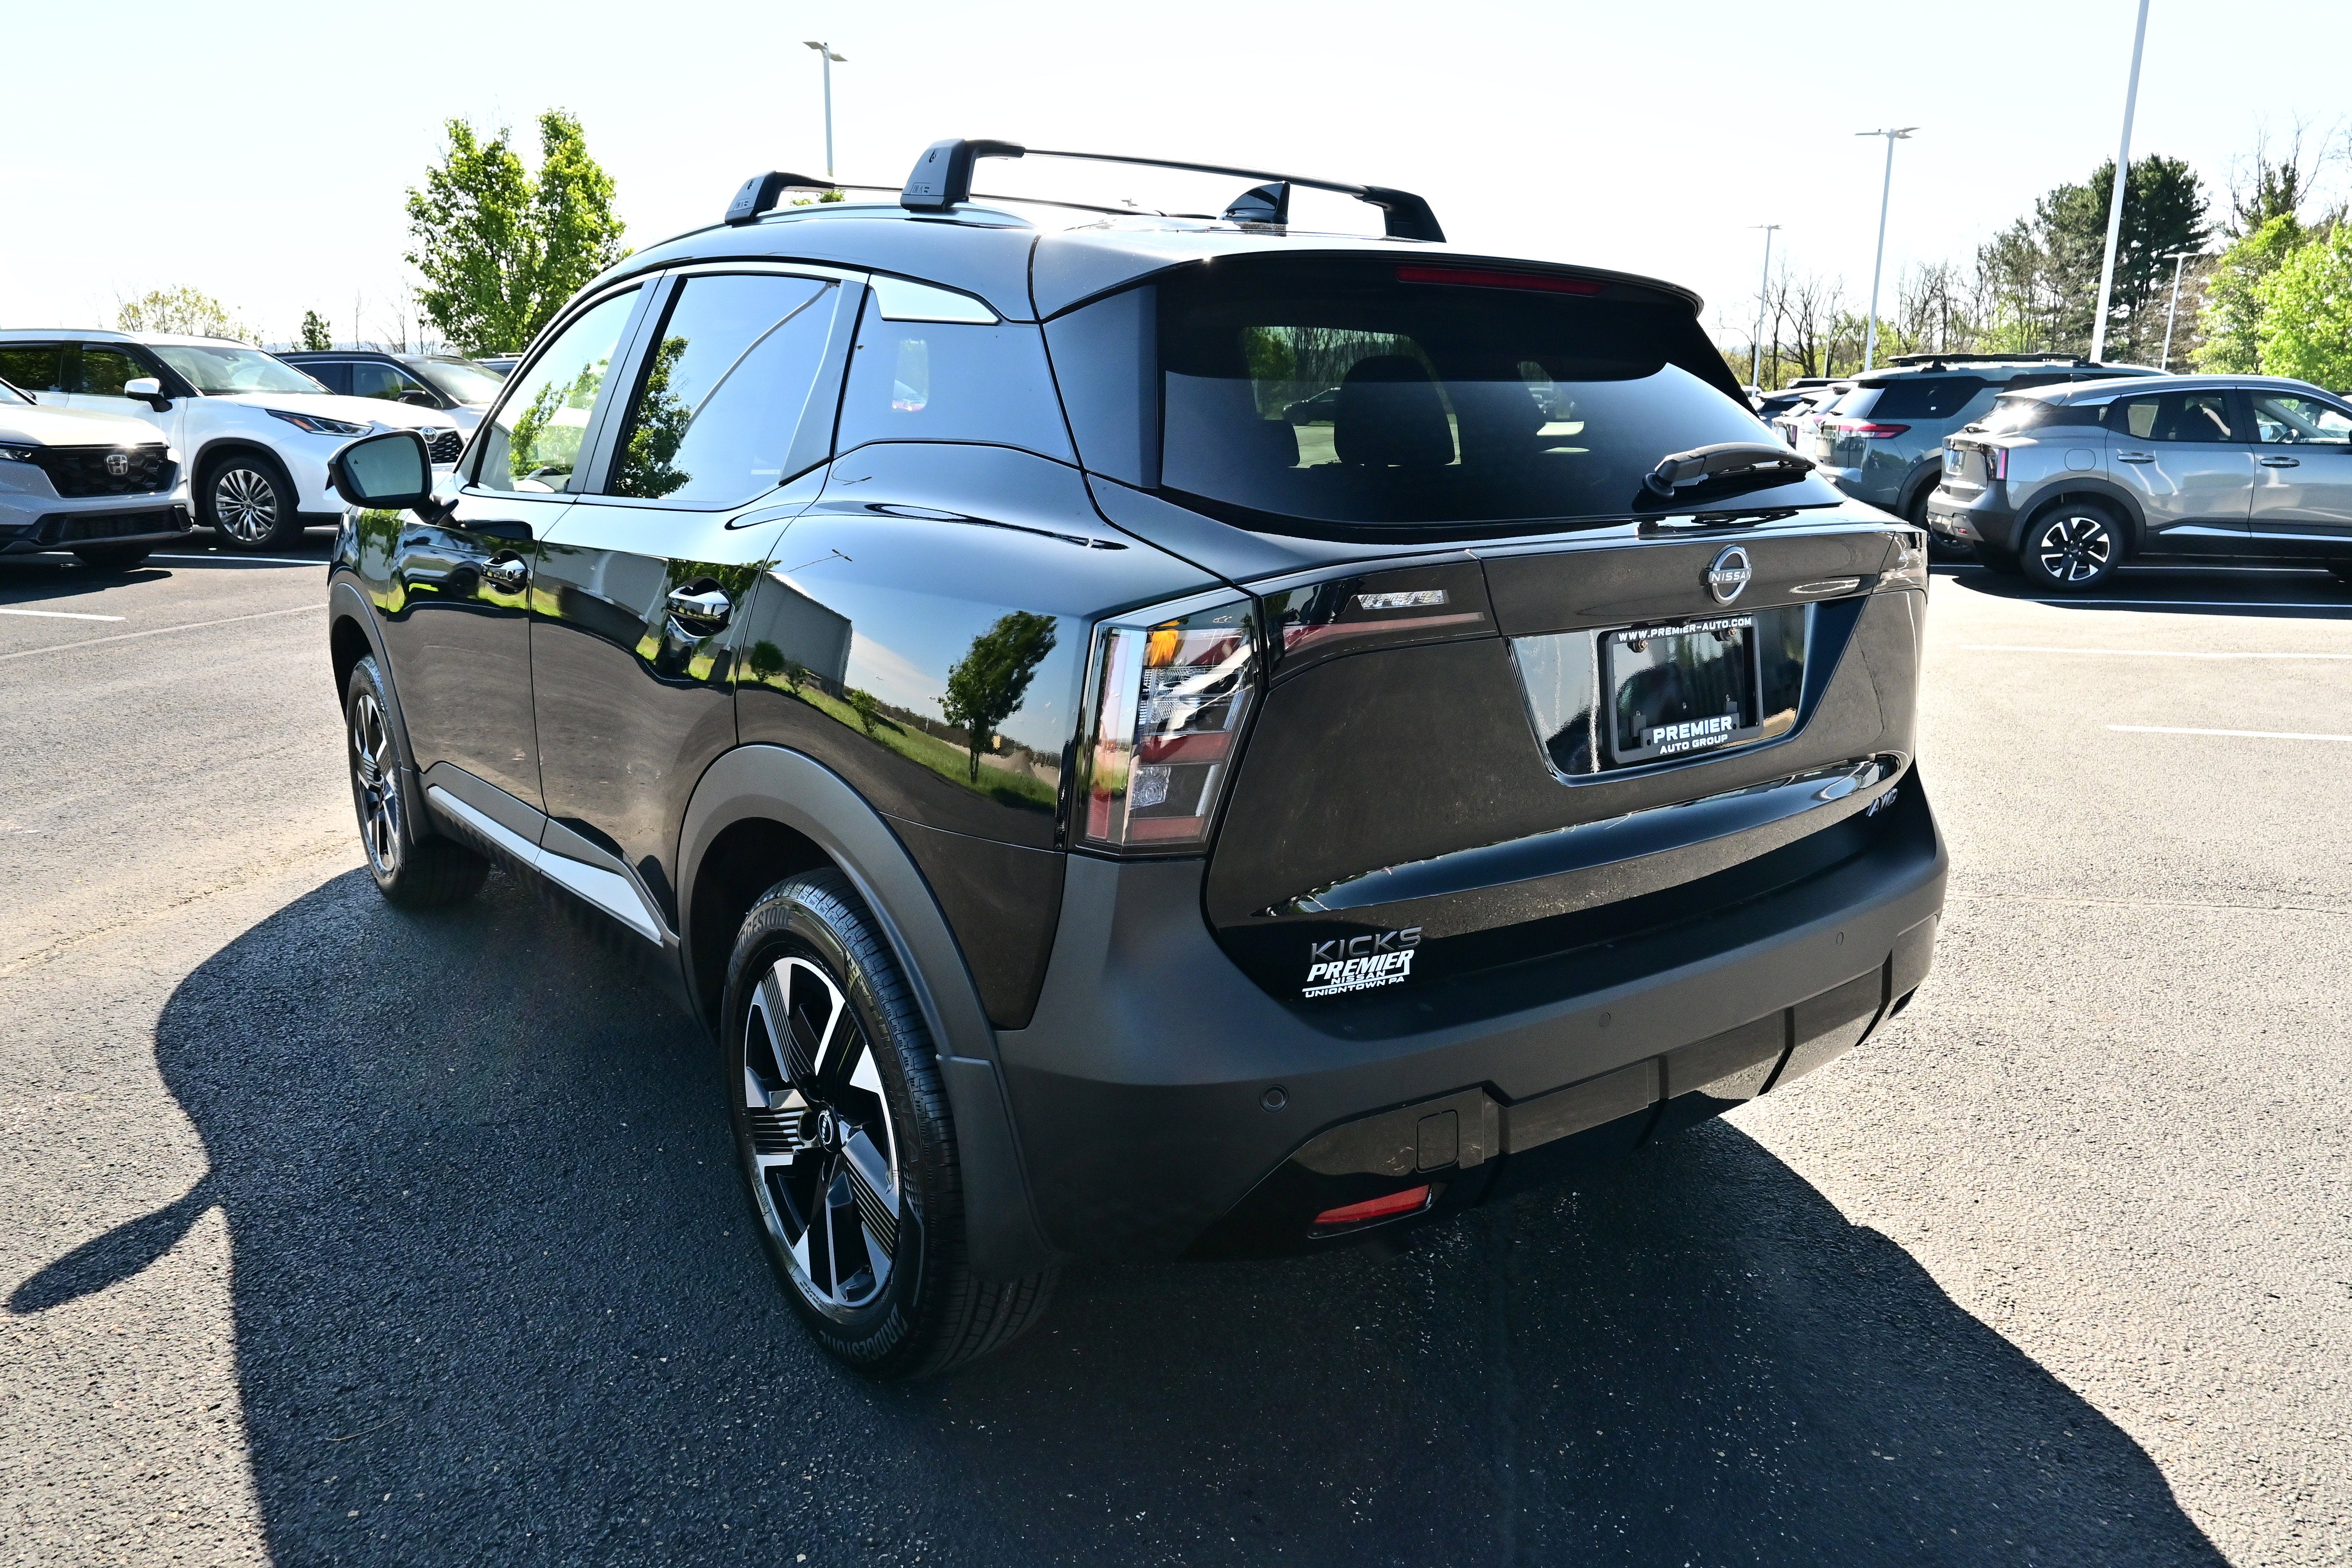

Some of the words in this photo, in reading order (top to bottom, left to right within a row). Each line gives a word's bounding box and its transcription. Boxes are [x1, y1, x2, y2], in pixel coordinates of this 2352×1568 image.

[1711, 570, 1751, 582] NISSAN
[1618, 617, 1751, 641] WWW.PREMIER-AUTO.COM
[1653, 716, 1732, 743] PREMIER
[1660, 741, 1689, 754] AUTO
[1692, 734, 1728, 748] GROUP
[1311, 926, 1422, 964] KICKS
[1307, 950, 1414, 982] PREMIER
[1305, 980, 1385, 998] UNIONTOWN
[1331, 971, 1386, 985] NISSAN
